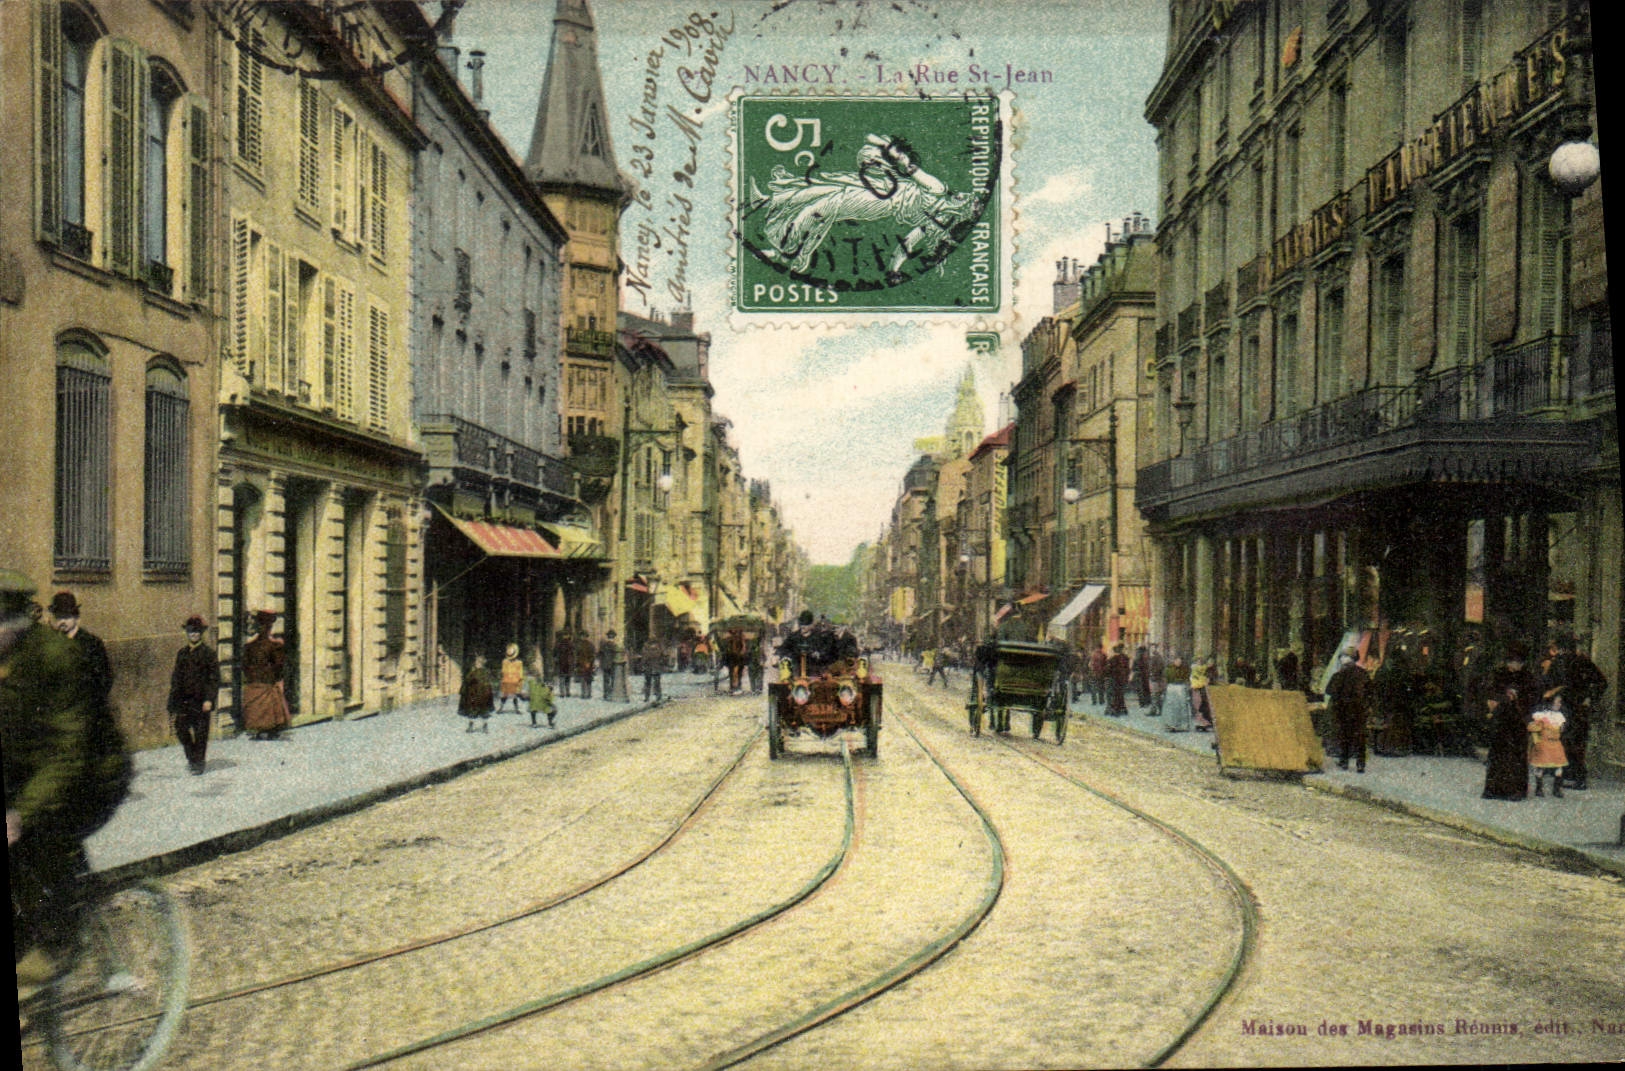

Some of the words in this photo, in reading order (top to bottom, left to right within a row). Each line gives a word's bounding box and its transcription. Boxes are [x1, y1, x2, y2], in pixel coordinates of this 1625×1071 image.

[630, 145, 653, 178] 23
[970, 222, 990, 304] FRANÇAISE
[753, 283, 839, 303] POSTES
